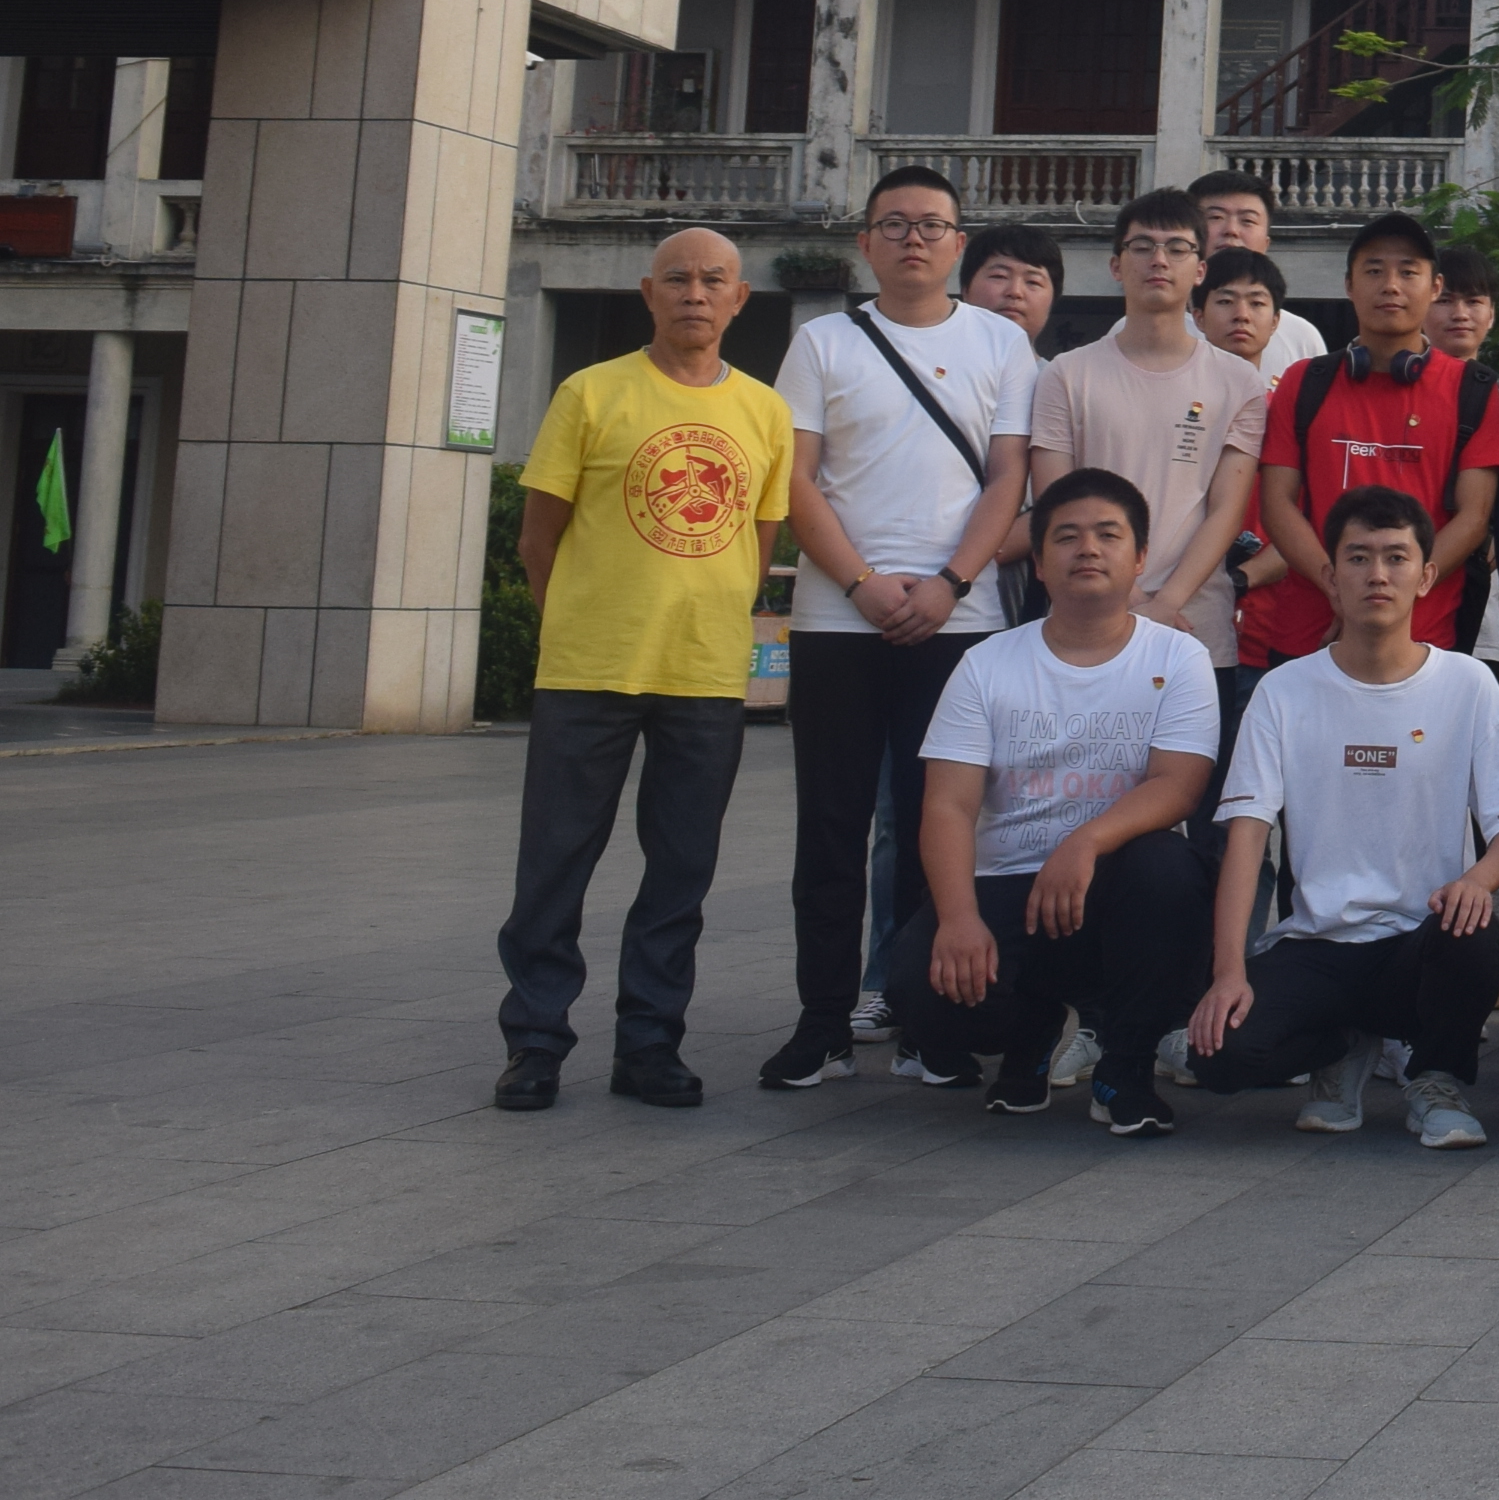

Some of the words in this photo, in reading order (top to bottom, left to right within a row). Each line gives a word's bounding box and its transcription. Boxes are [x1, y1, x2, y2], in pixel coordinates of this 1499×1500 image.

[1010, 709, 1058, 740] I'M
[1065, 711, 1152, 740] OKAY
[1007, 740, 1056, 769] I'M
[1063, 742, 1150, 771] OKAY
